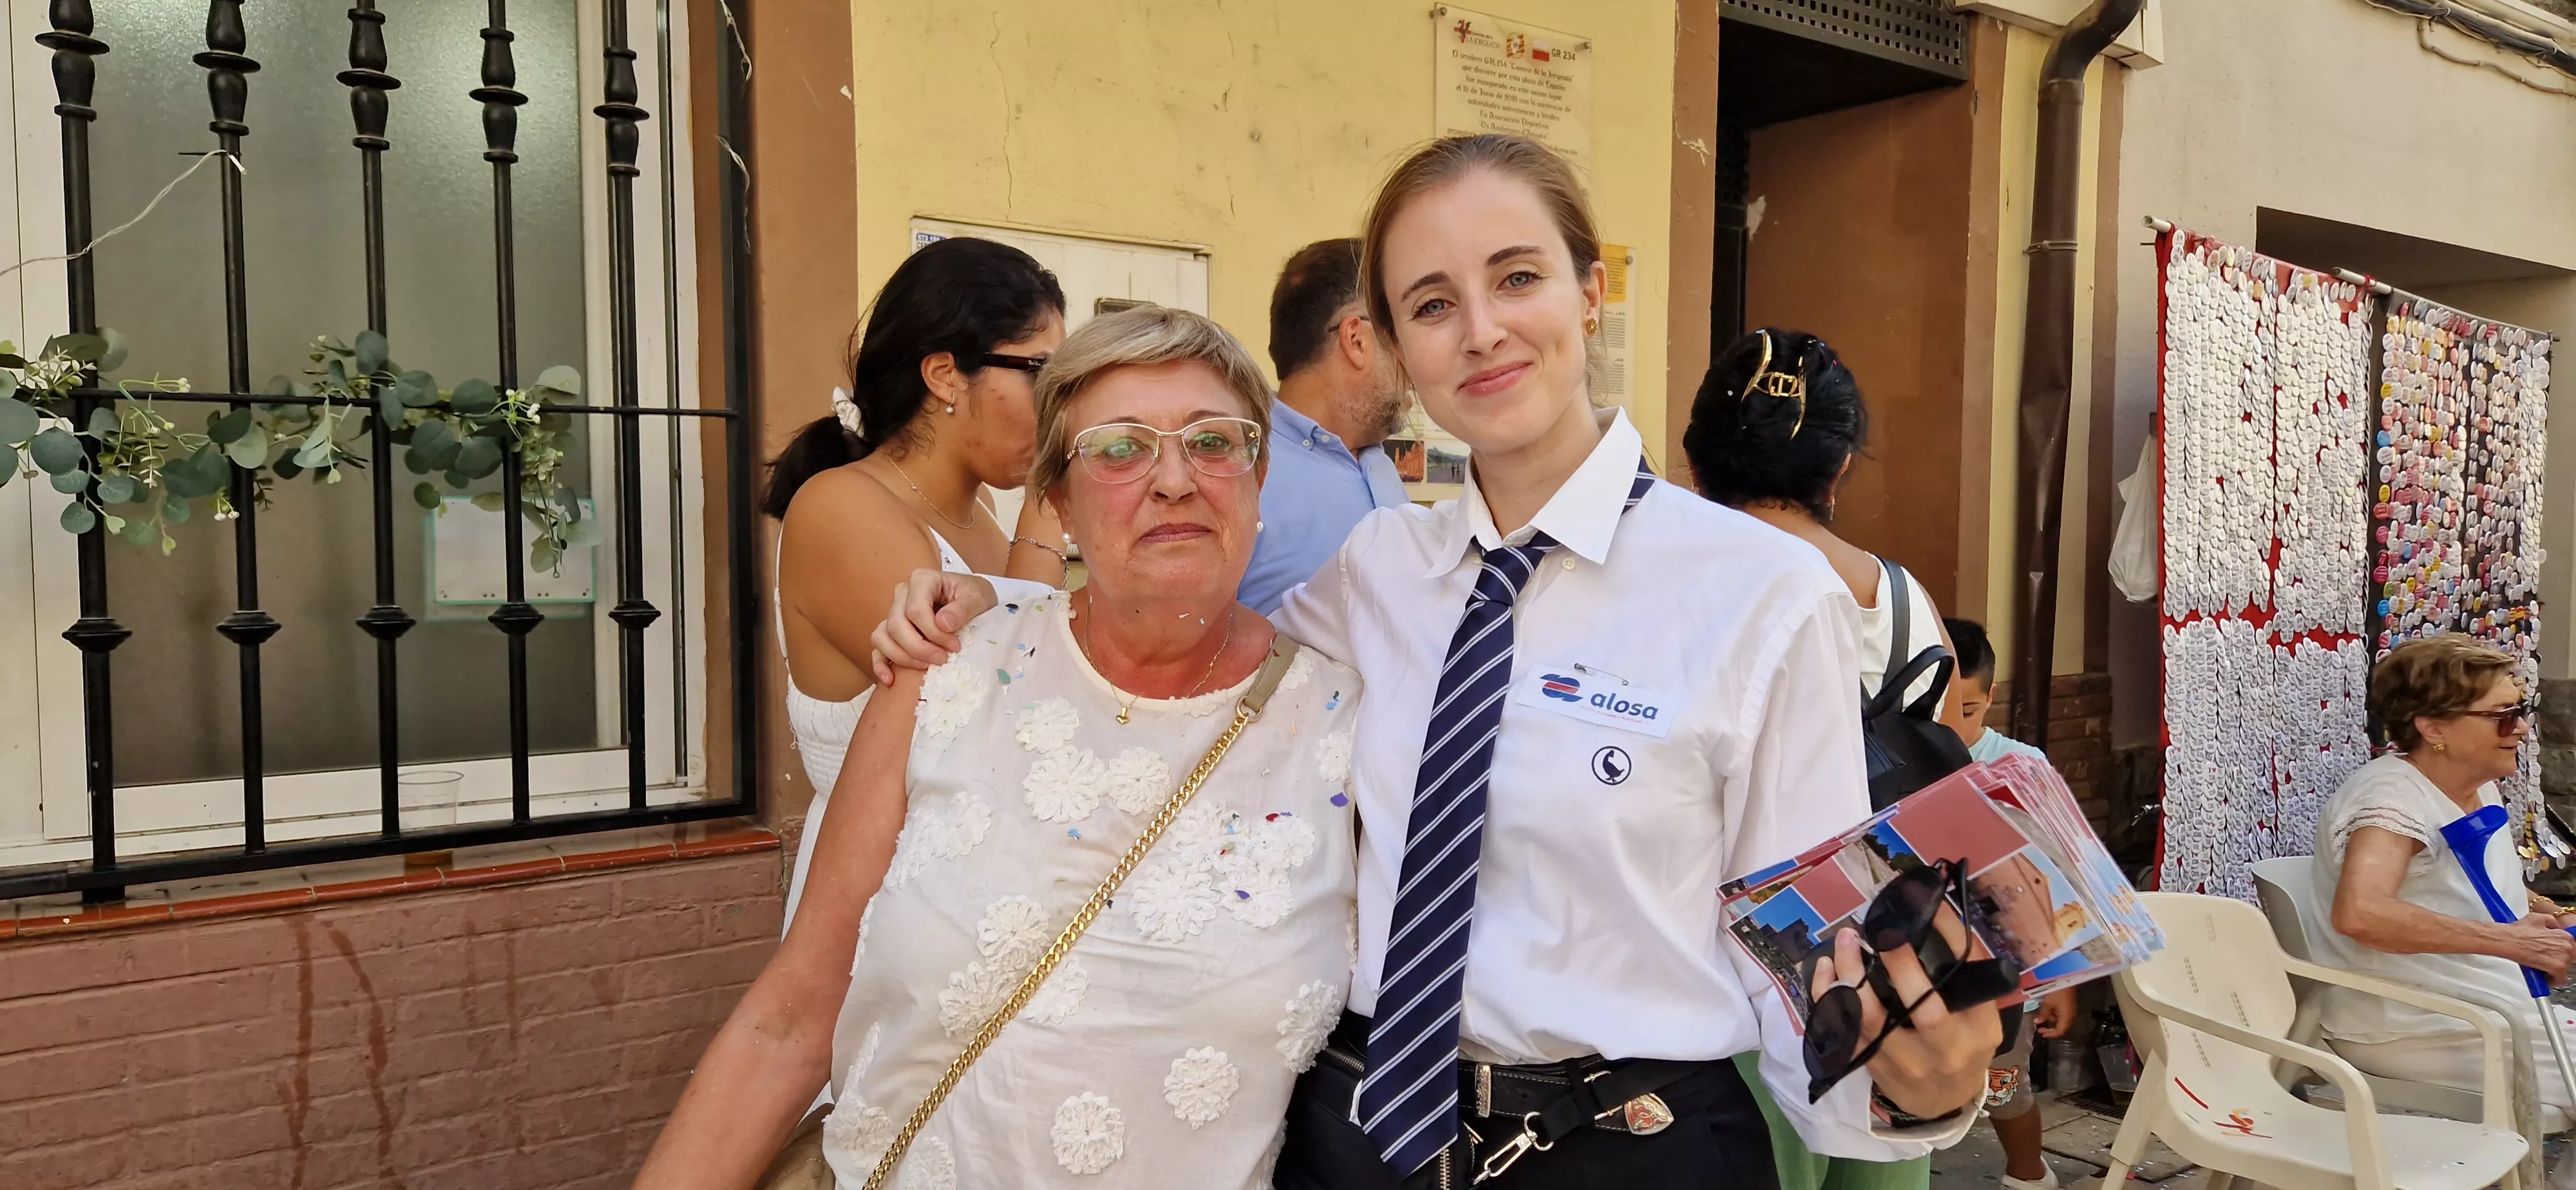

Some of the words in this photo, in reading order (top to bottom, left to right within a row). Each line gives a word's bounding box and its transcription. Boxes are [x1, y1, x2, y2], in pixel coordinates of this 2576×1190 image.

[1460, 54, 1482, 63] sendero
[1484, 57, 1495, 67] GR
[1551, 48, 1561, 58] GR
[1563, 51, 1576, 61] 234
[1473, 66, 1496, 76] discurre
[1522, 77, 1536, 85] plaza
[1476, 79, 1508, 90] inaugurado
[1468, 99, 1500, 109] autoridades
[1480, 110, 1487, 118] La
[1522, 118, 1548, 129] Deportiva
[1590, 693, 1659, 720] alosa
